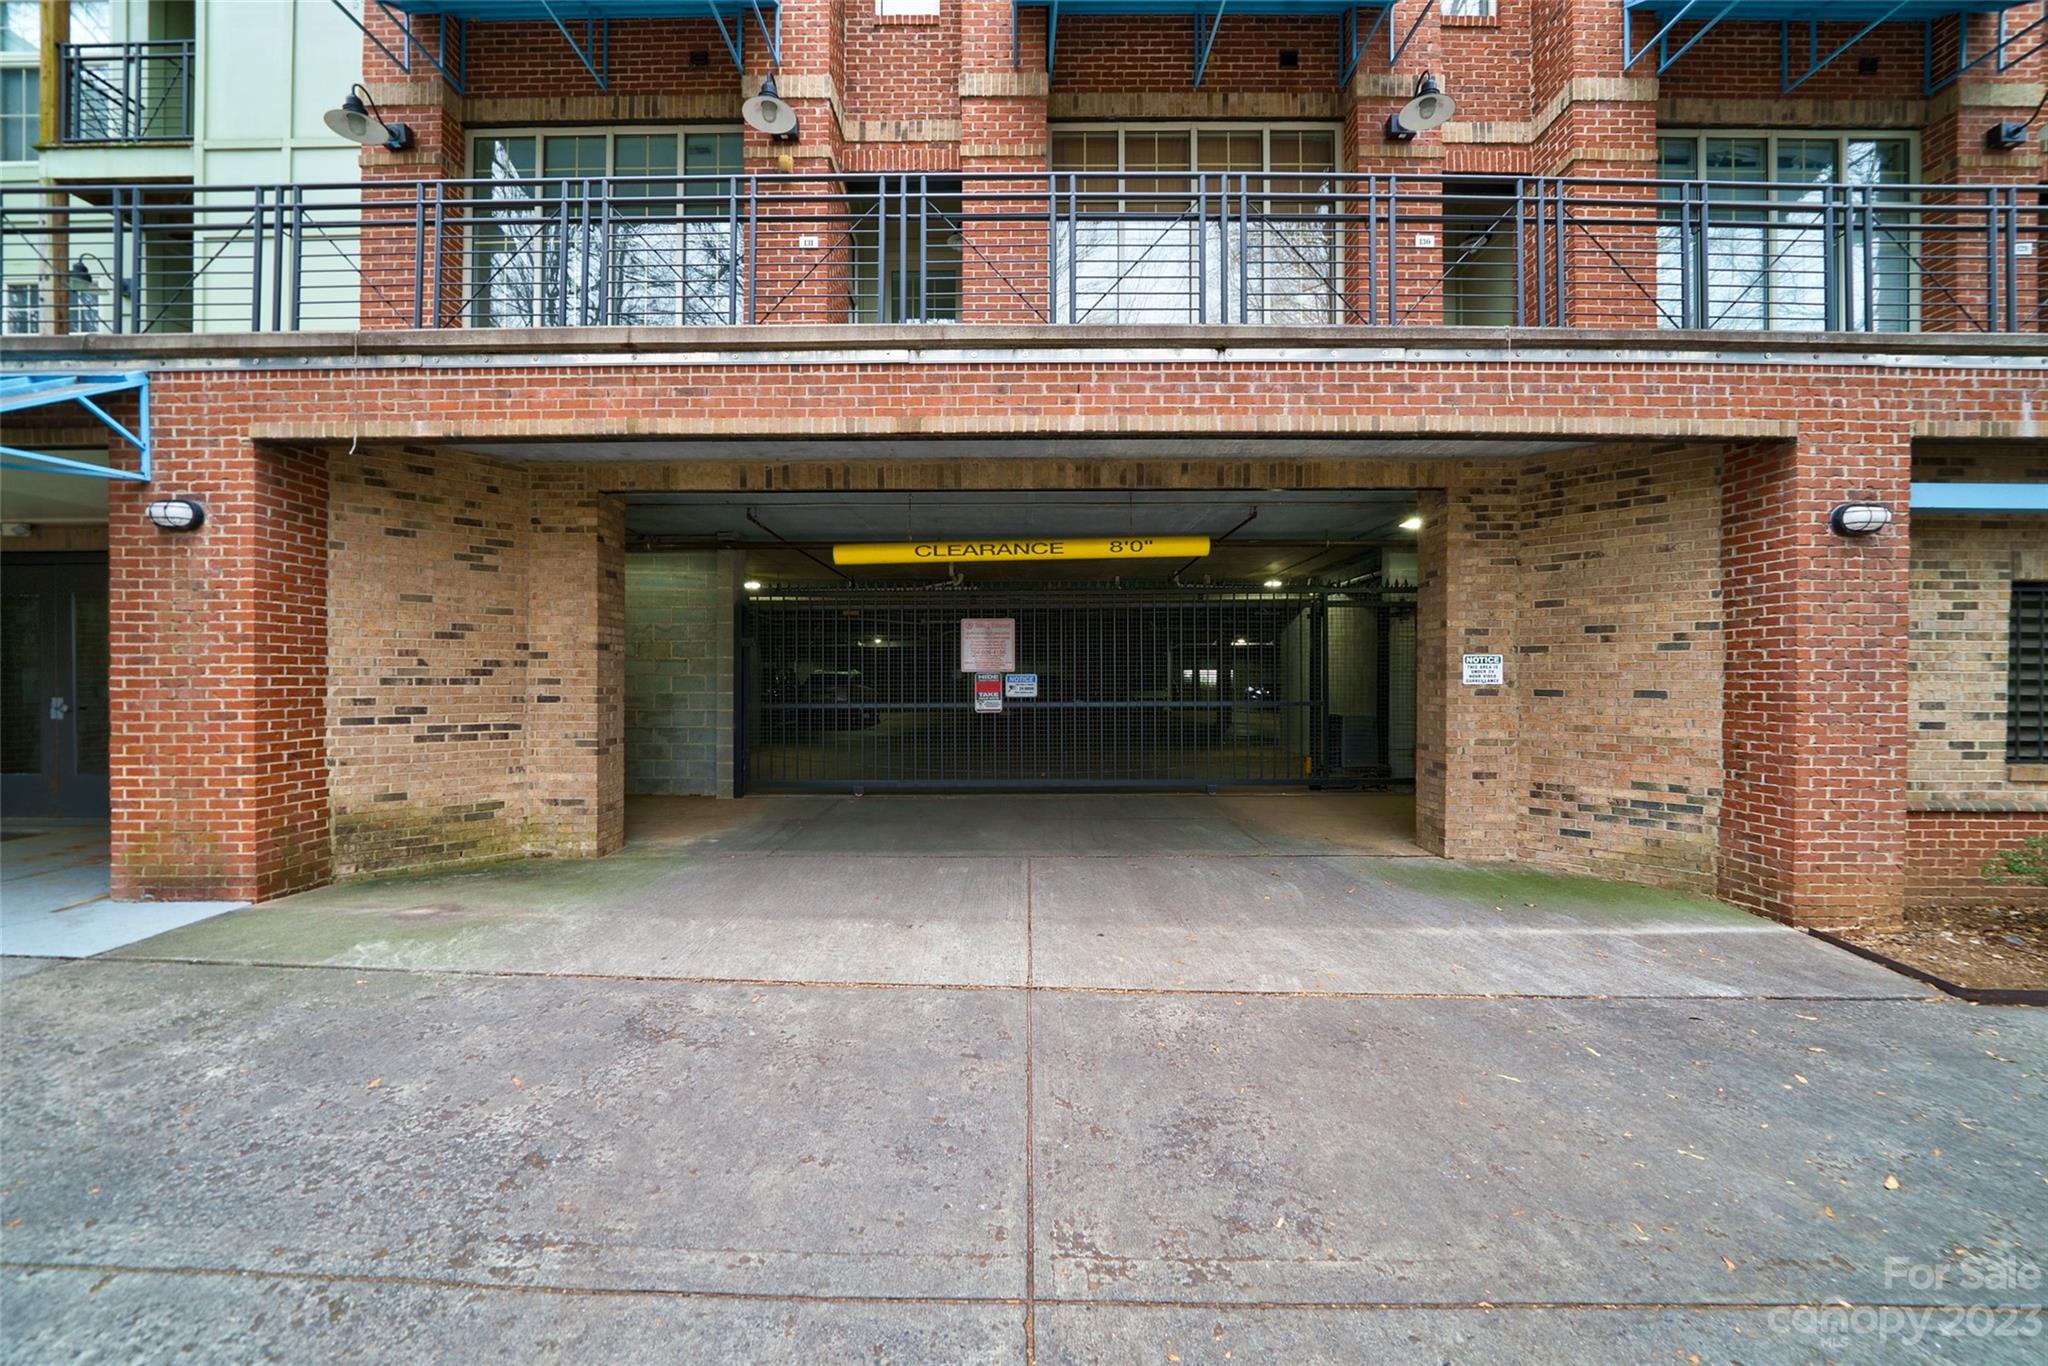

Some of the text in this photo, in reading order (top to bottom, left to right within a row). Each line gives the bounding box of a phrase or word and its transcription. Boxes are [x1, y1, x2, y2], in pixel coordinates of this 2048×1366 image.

[914, 539, 1153, 557] CLEARANCE 8'0"
[1466, 656, 1500, 664] NOTICE
